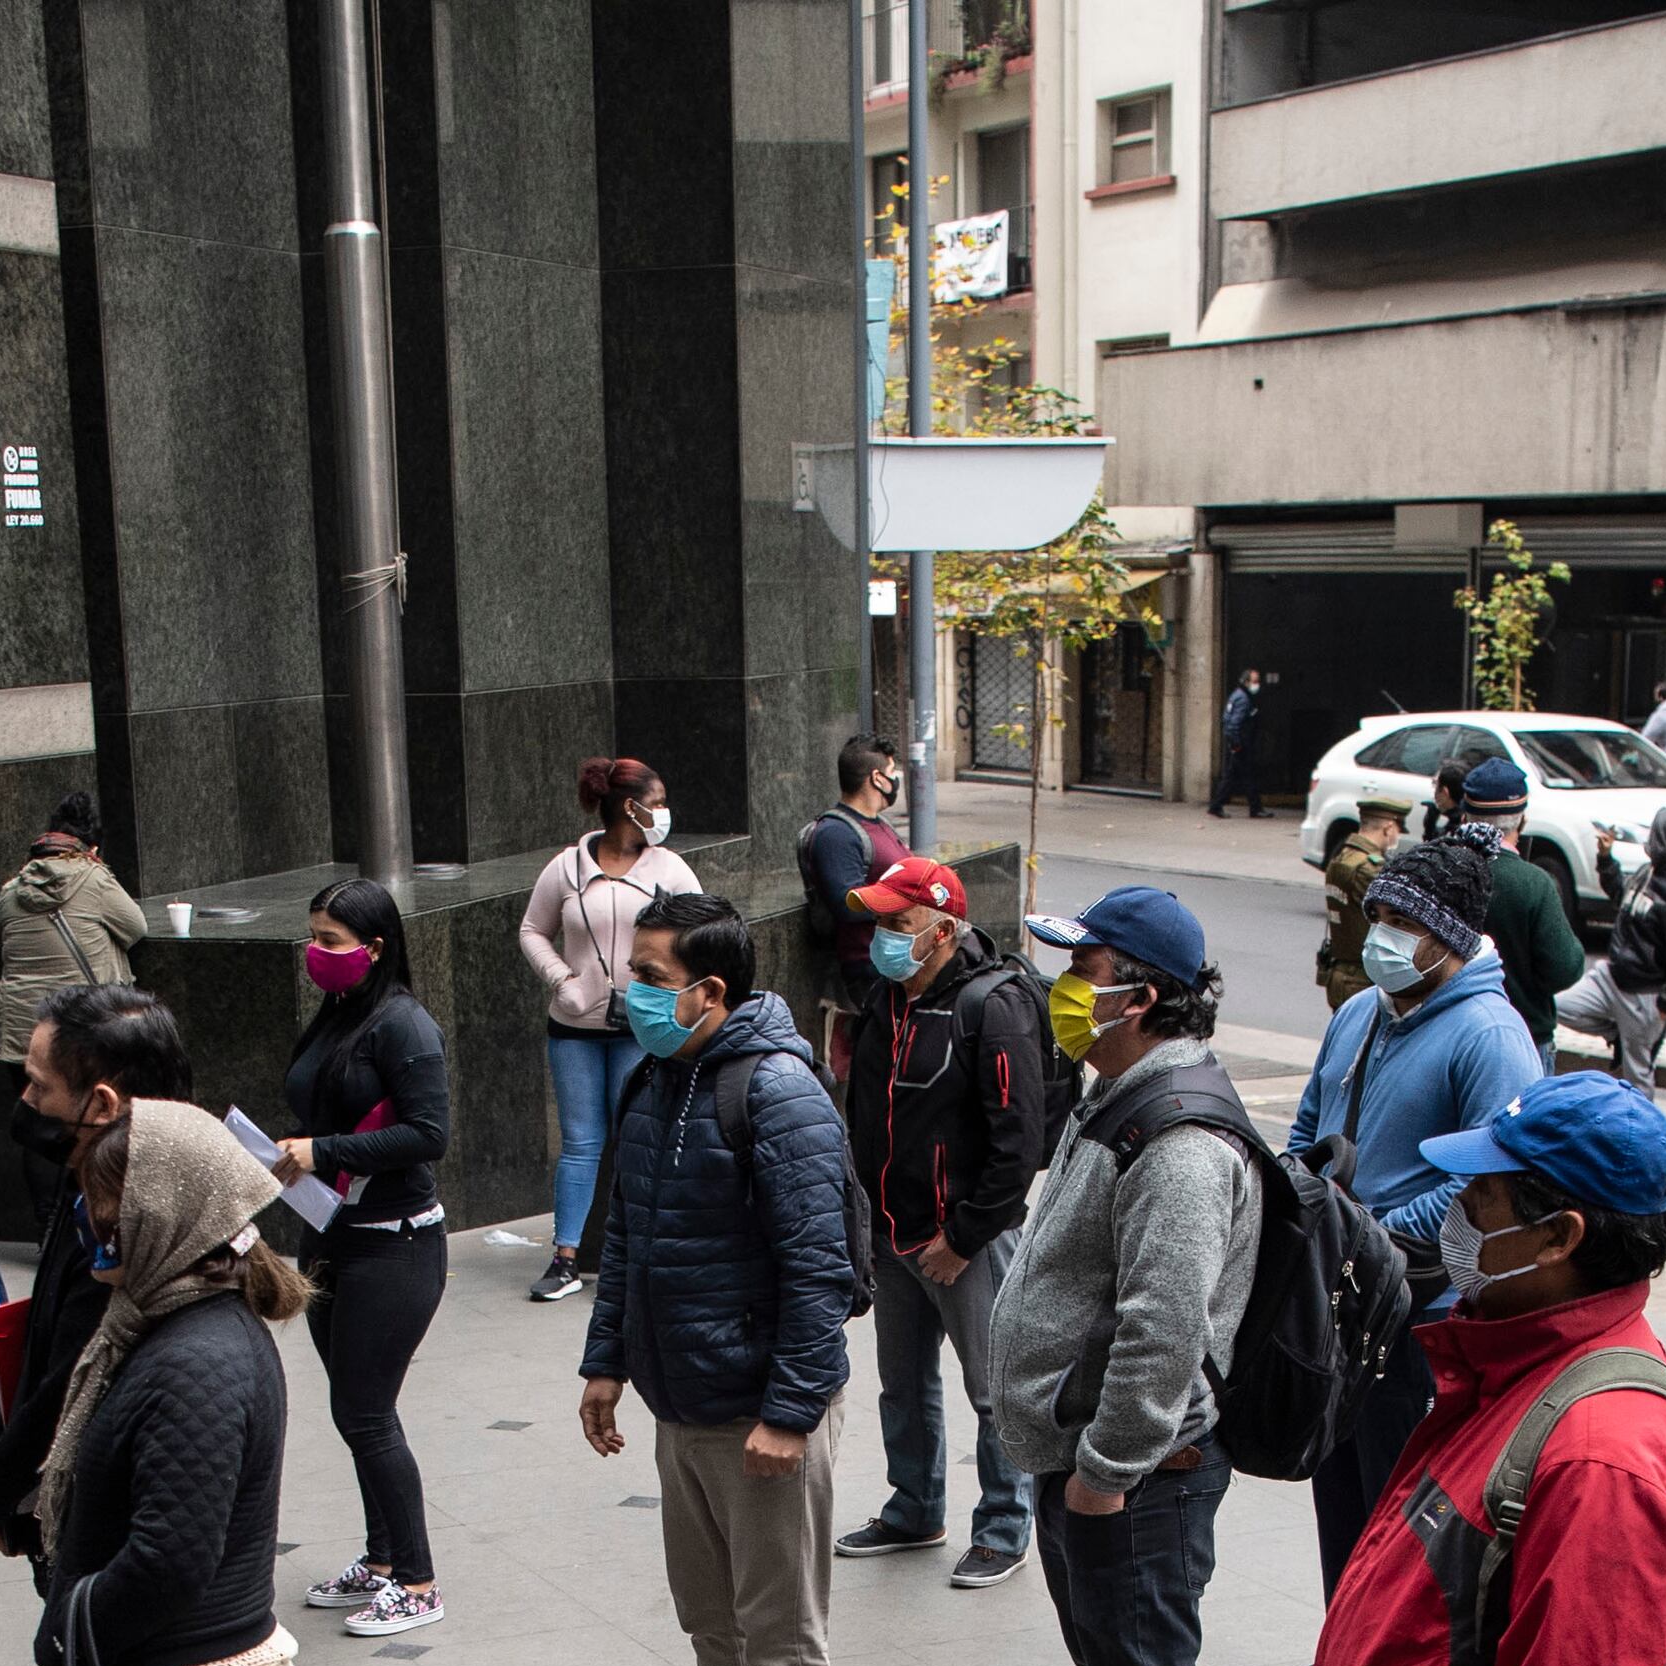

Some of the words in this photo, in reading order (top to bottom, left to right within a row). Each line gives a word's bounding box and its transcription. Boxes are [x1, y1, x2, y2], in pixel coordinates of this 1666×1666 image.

[4, 489, 42, 509] FUMAR
[5, 514, 19, 527] LEY
[19, 514, 44, 527] 20.660
